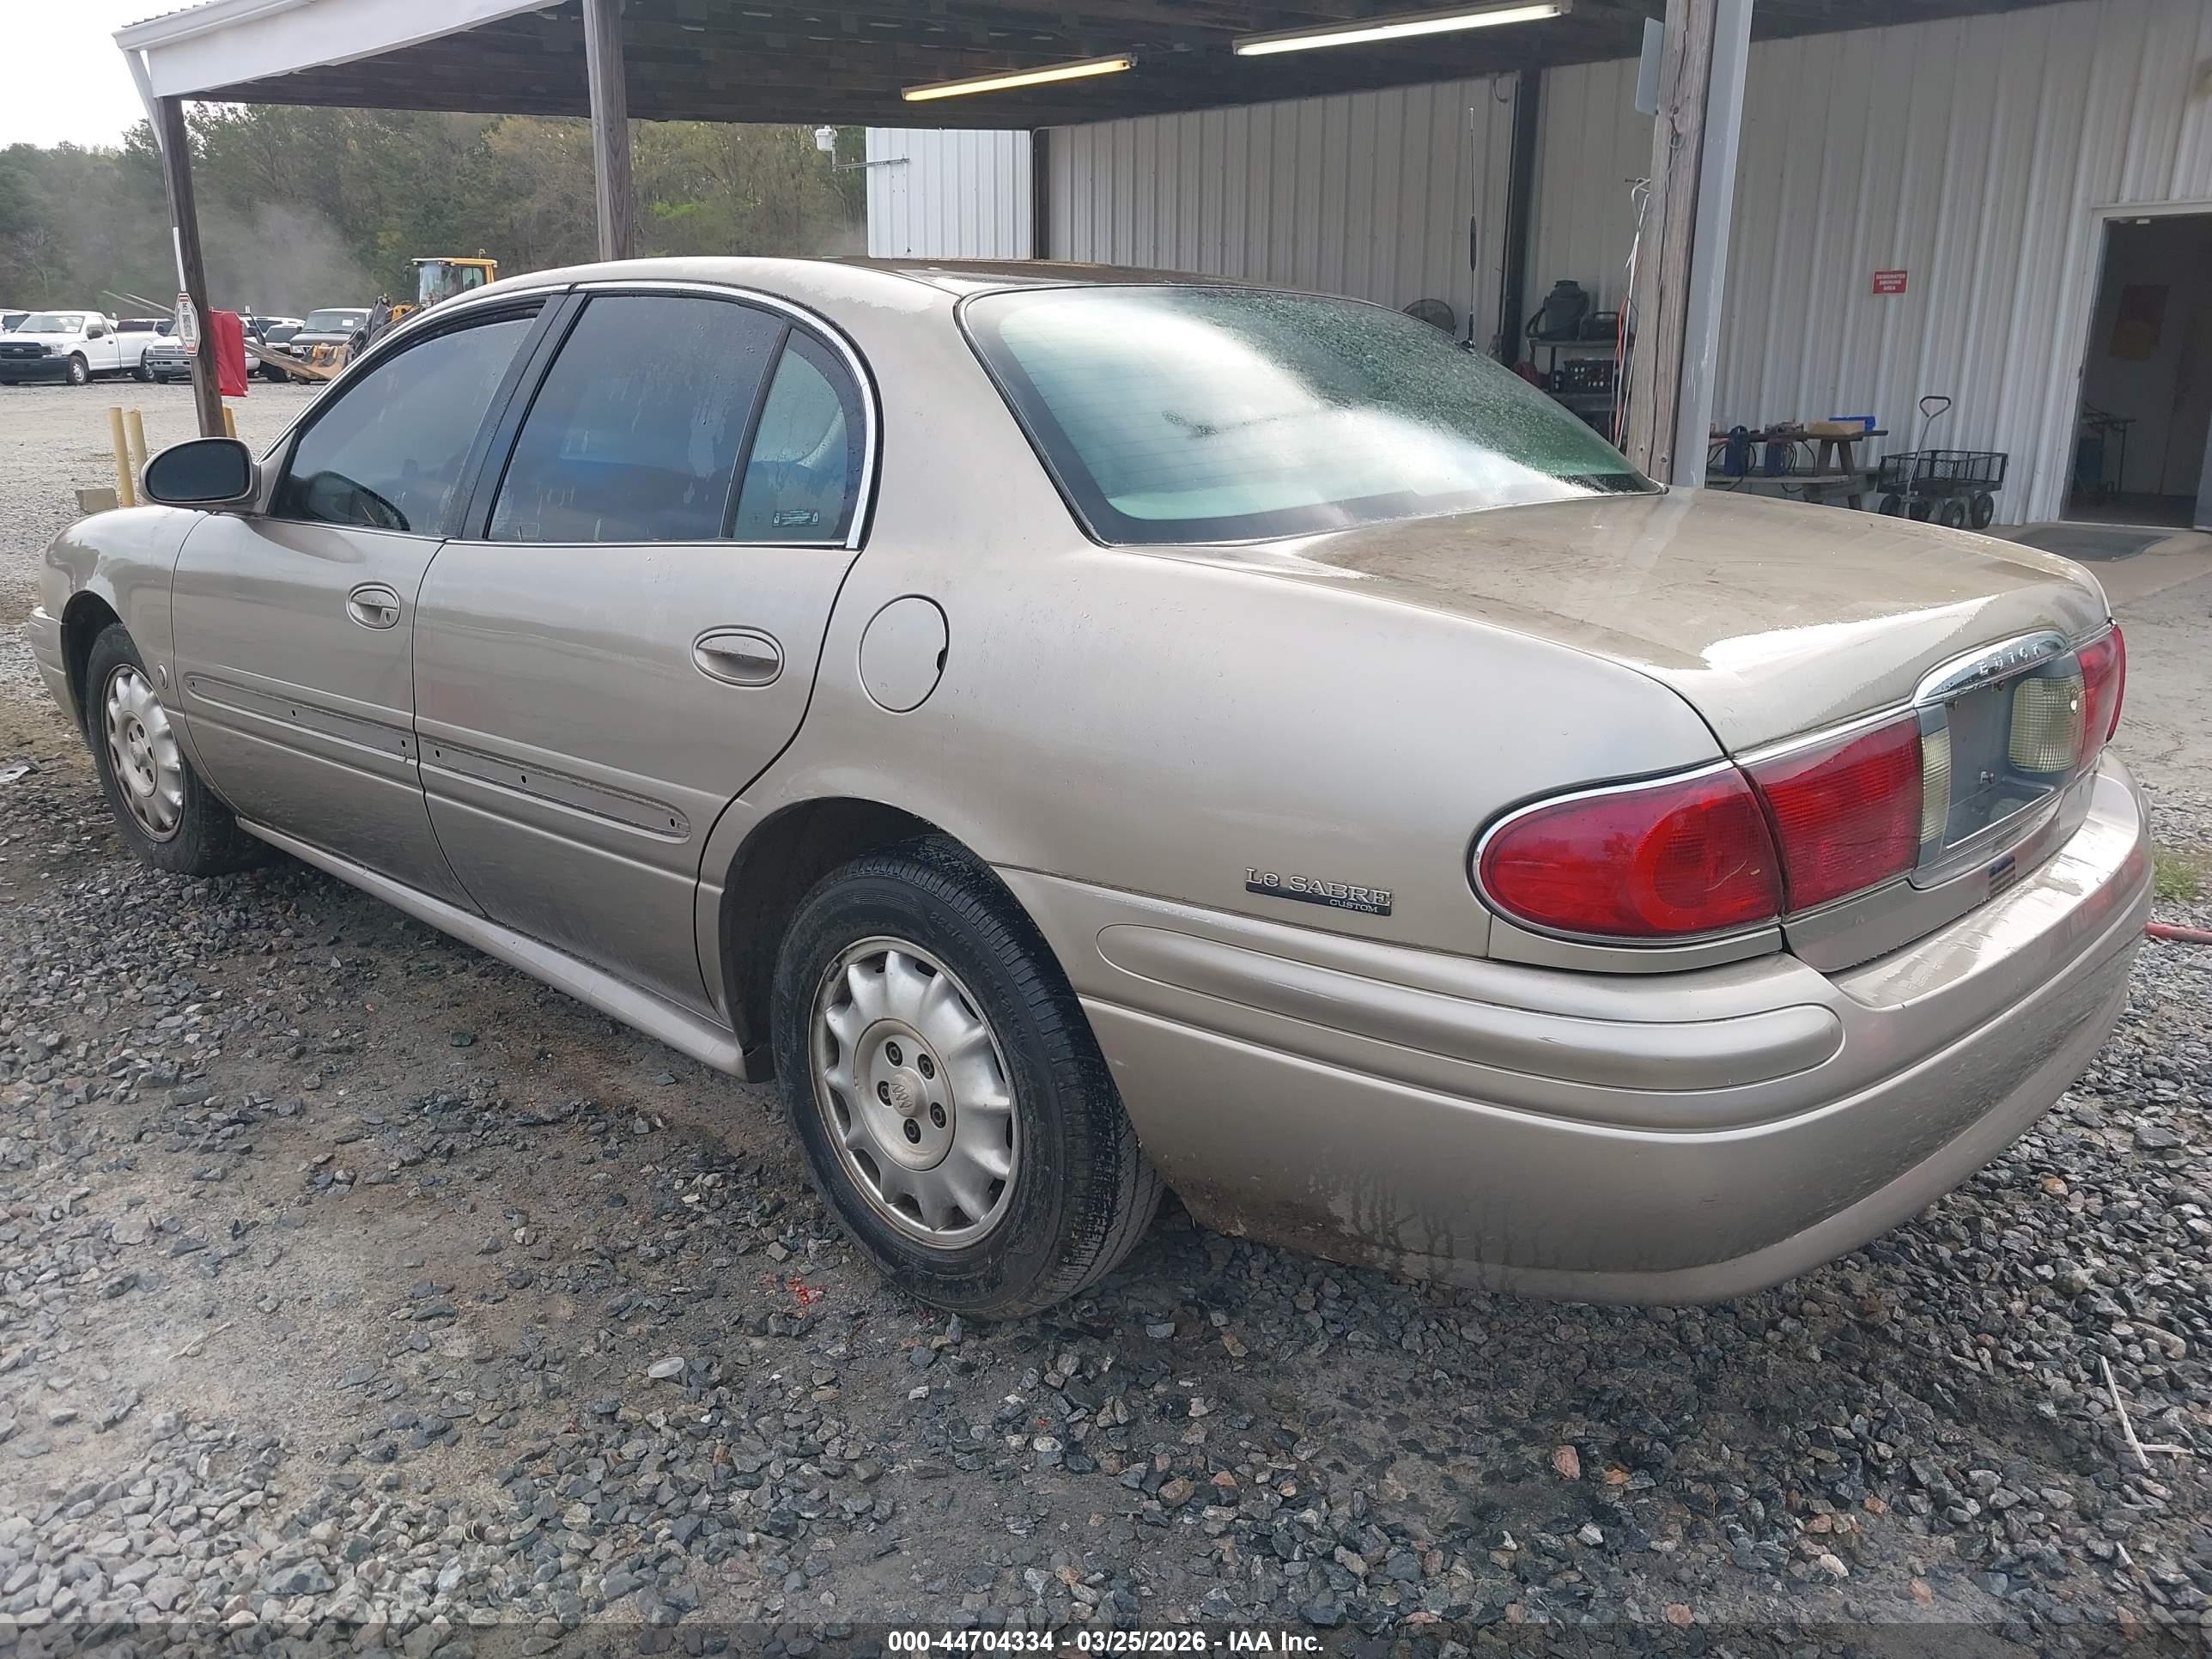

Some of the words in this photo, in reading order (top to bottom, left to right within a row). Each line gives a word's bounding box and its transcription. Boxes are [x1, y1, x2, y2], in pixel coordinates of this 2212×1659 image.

[1245, 867, 1279, 887] Le
[1289, 875, 1391, 907] SABRE
[1328, 898, 1379, 914] CUSTOM
